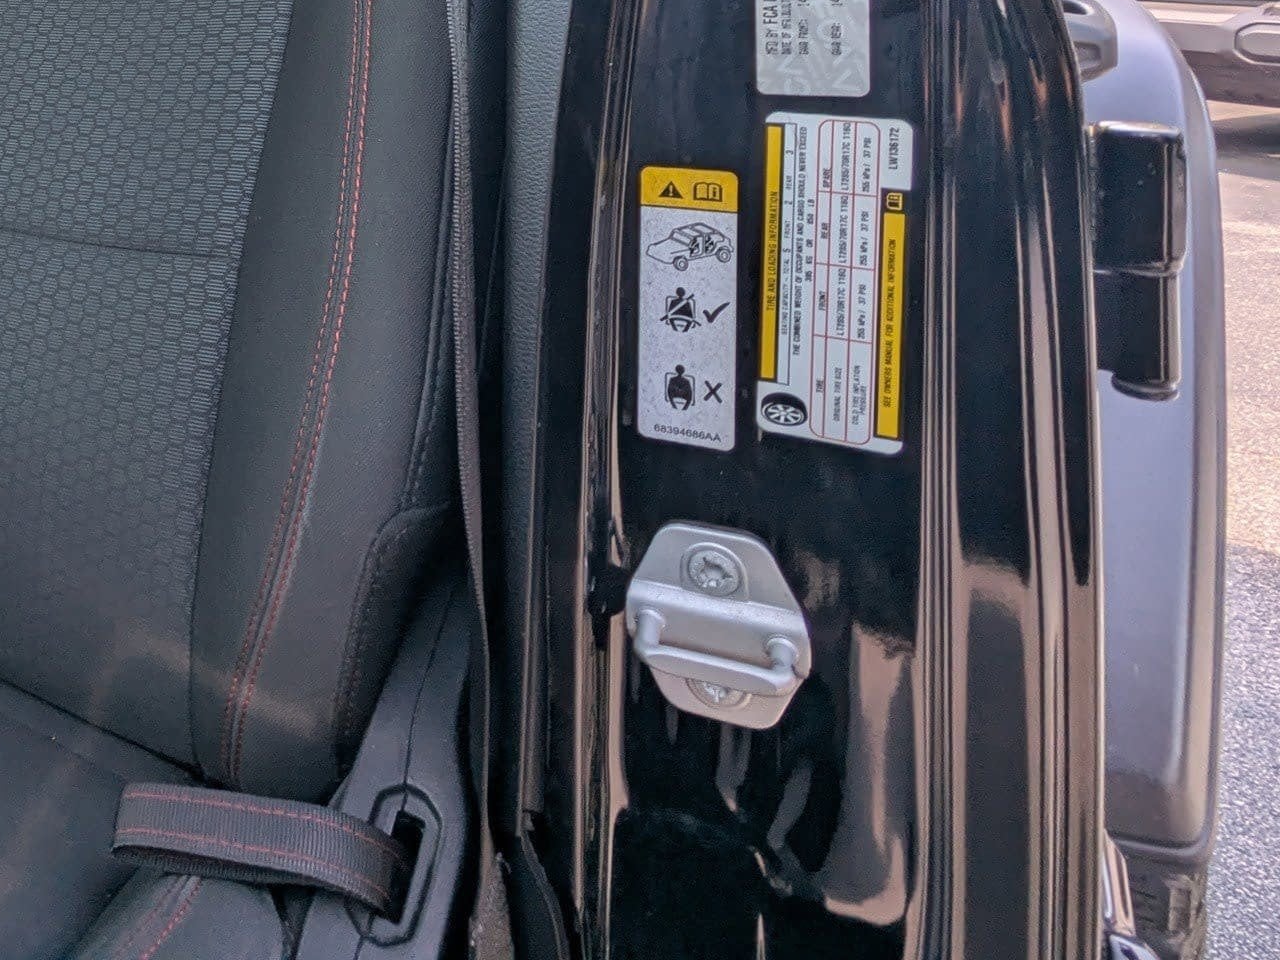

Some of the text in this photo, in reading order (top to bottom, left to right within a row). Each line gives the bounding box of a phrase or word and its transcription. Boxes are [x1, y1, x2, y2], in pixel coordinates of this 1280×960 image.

[763, 5, 777, 24] FCA
[799, 127, 807, 150] EXCEED
[864, 137, 872, 148] PSI
[889, 127, 899, 169] LW136172
[798, 152, 806, 172] NEVER
[864, 150, 871, 158] 37
[798, 173, 806, 198] SHOULD
[823, 168, 831, 188] SPARE
[861, 211, 869, 222] PSI
[796, 223, 804, 235] AND
[821, 223, 829, 239] REAR
[861, 223, 868, 232] 37
[767, 192, 779, 311] TIRE AND LOADING INFORMATION
[795, 237, 803, 273] OCCUPANTS
[795, 275, 802, 283] OF
[794, 285, 802, 308] WEIGHT
[859, 297, 866, 305] 37
[793, 311, 801, 342] COMBINED
[883, 239, 896, 407] SEE OWNERS MANUAL FOR ADDITIONAL INFORMATION
[816, 379, 824, 392] TIRE
[833, 367, 842, 422] ORIGINAL TIRE SIZE
